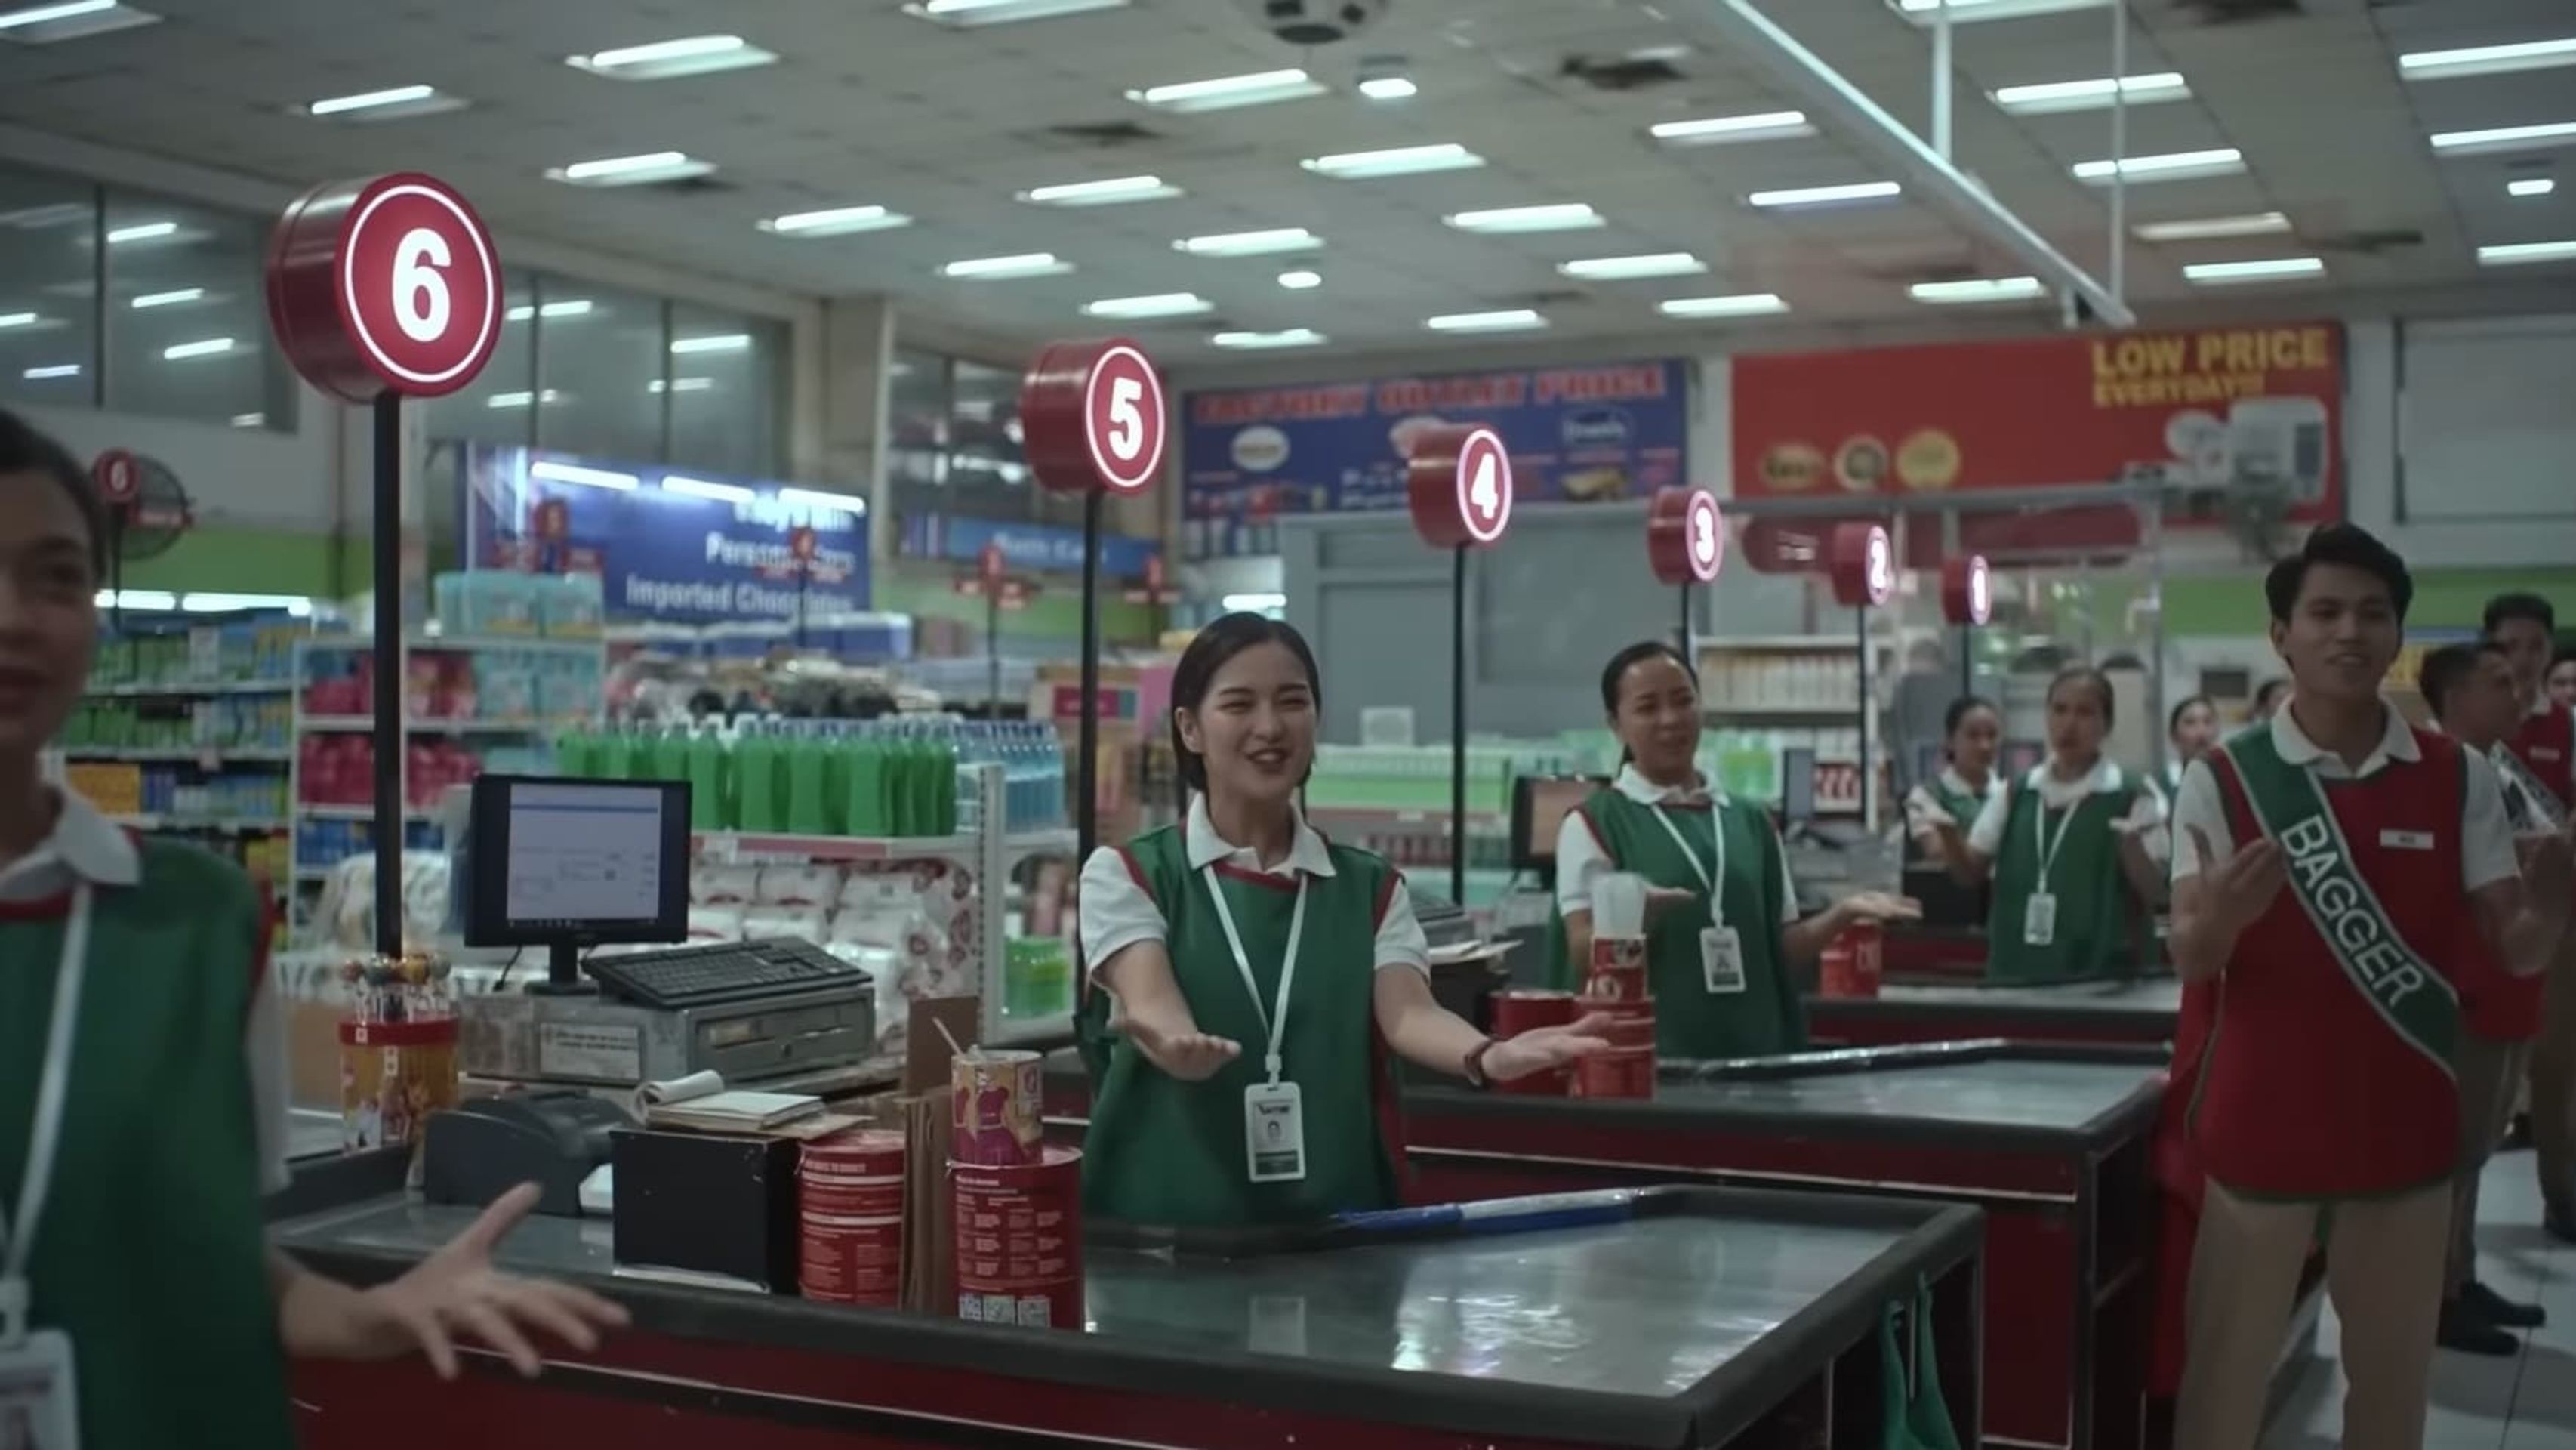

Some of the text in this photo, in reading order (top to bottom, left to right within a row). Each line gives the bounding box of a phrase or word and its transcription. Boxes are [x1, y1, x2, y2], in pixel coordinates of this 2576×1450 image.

[392, 228, 451, 341] 6
[2093, 328, 2328, 376] LOW PRICE
[1108, 377, 1143, 460] 5
[1471, 452, 1499, 519] 4
[1695, 507, 1715, 563] 3
[1871, 540, 1887, 588] 2
[1971, 569, 1986, 612] 1
[2279, 813, 2424, 1007] BAGGER
